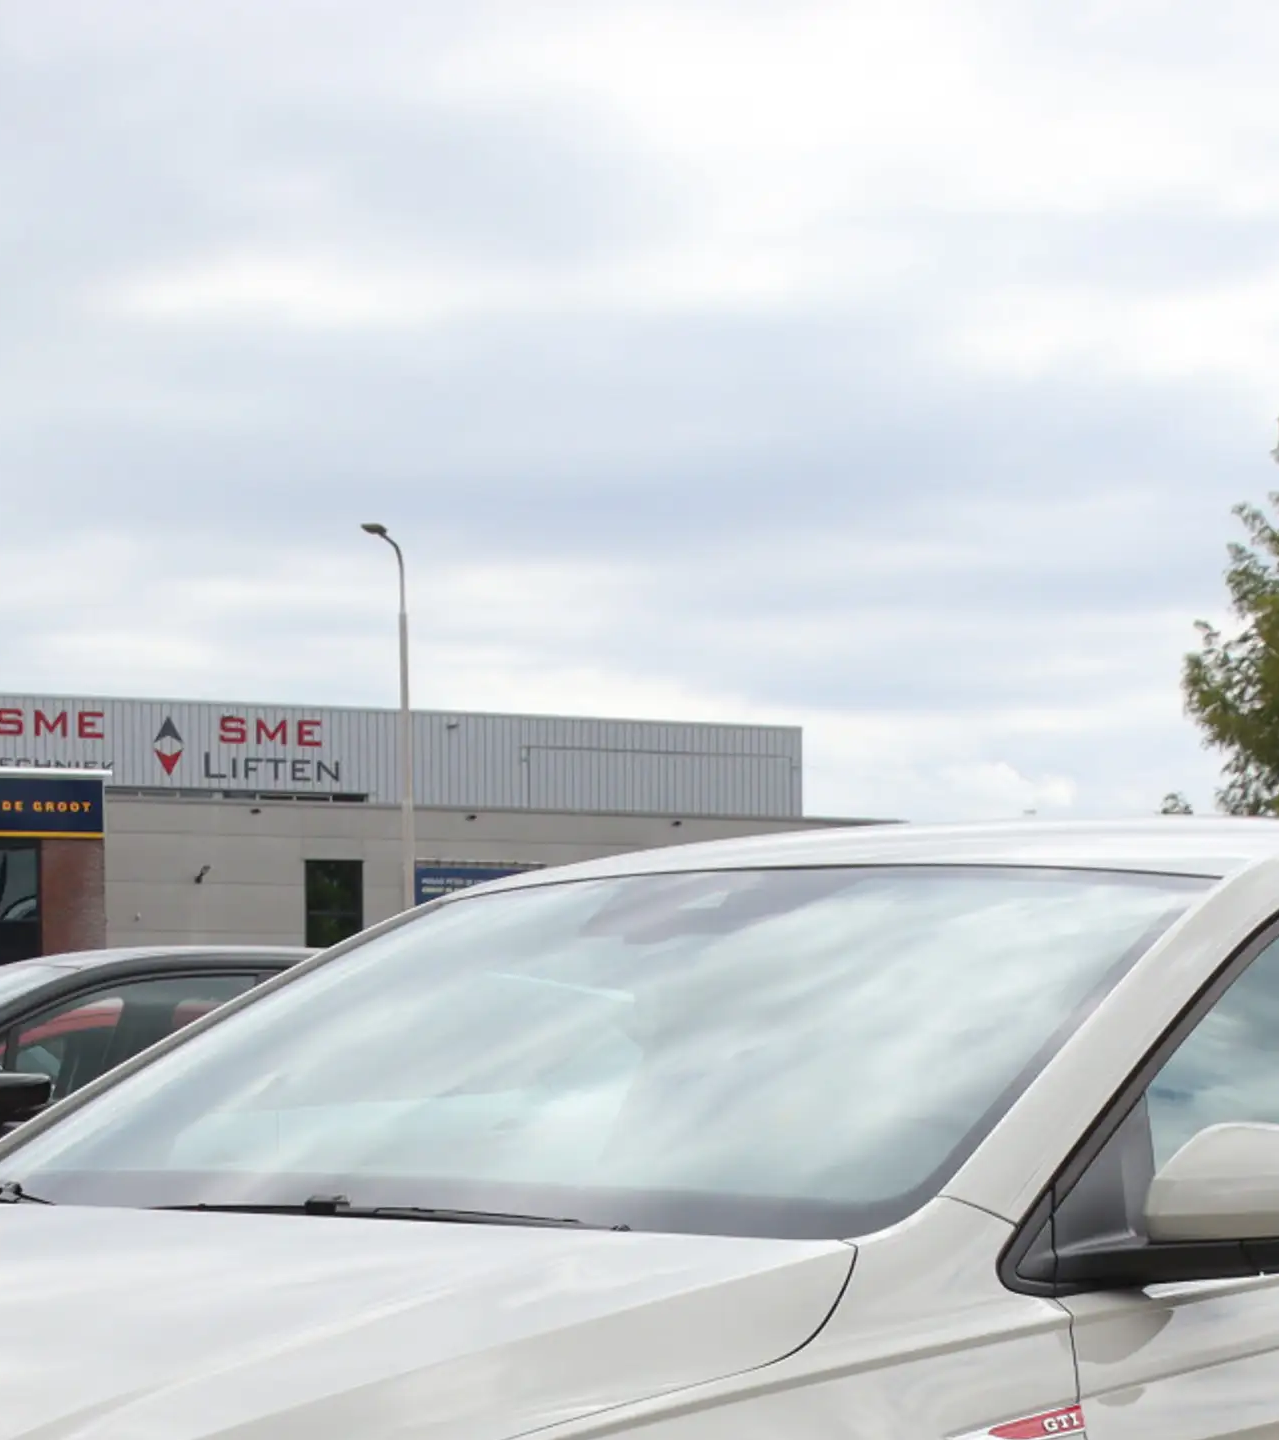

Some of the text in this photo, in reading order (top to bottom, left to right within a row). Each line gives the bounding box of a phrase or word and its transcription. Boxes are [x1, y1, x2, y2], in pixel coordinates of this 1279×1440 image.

[219, 716, 323, 747] SME
[204, 752, 340, 782] LIFTEN
[2, 800, 24, 812] DE
[33, 801, 92, 813] GROOT
[1043, 1412, 1081, 1433] GTI
